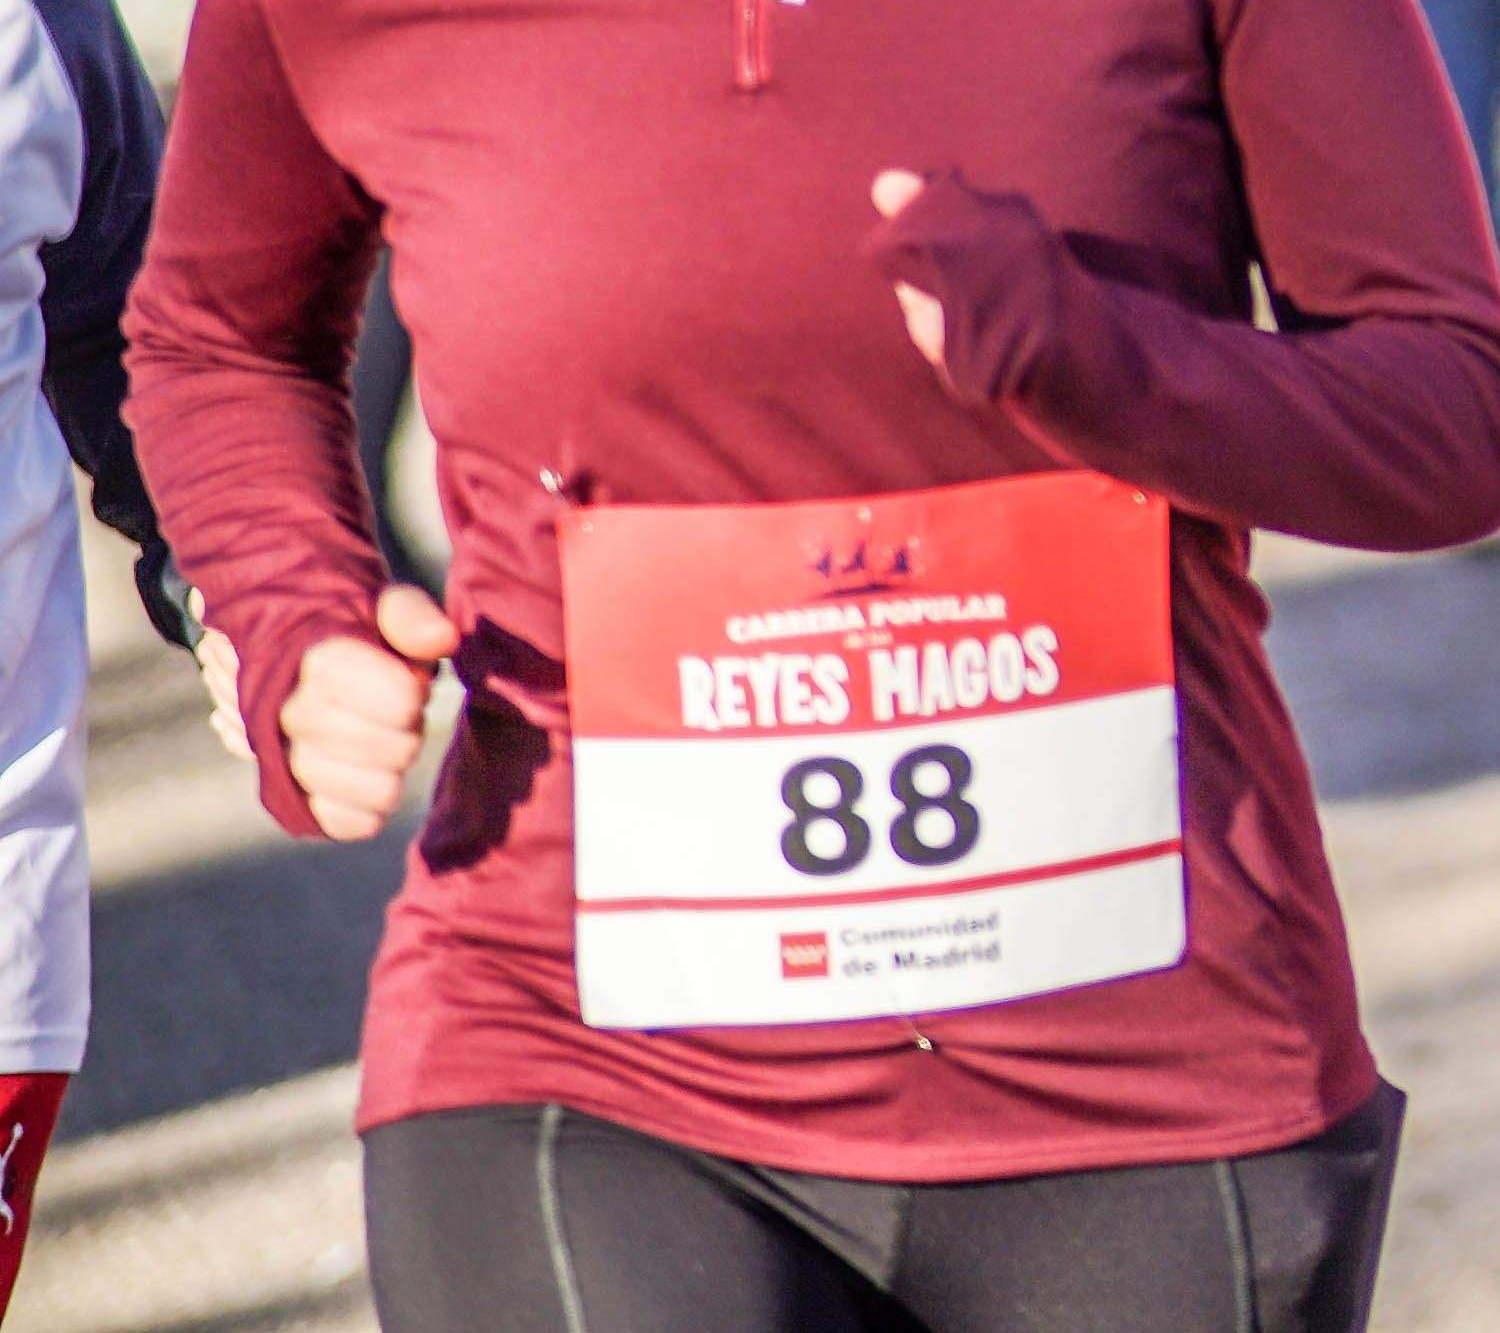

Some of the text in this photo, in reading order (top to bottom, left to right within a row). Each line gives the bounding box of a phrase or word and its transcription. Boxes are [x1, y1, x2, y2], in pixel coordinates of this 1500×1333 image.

[678, 624, 1061, 731] REYES MAGOS
[778, 742, 982, 878] 88
